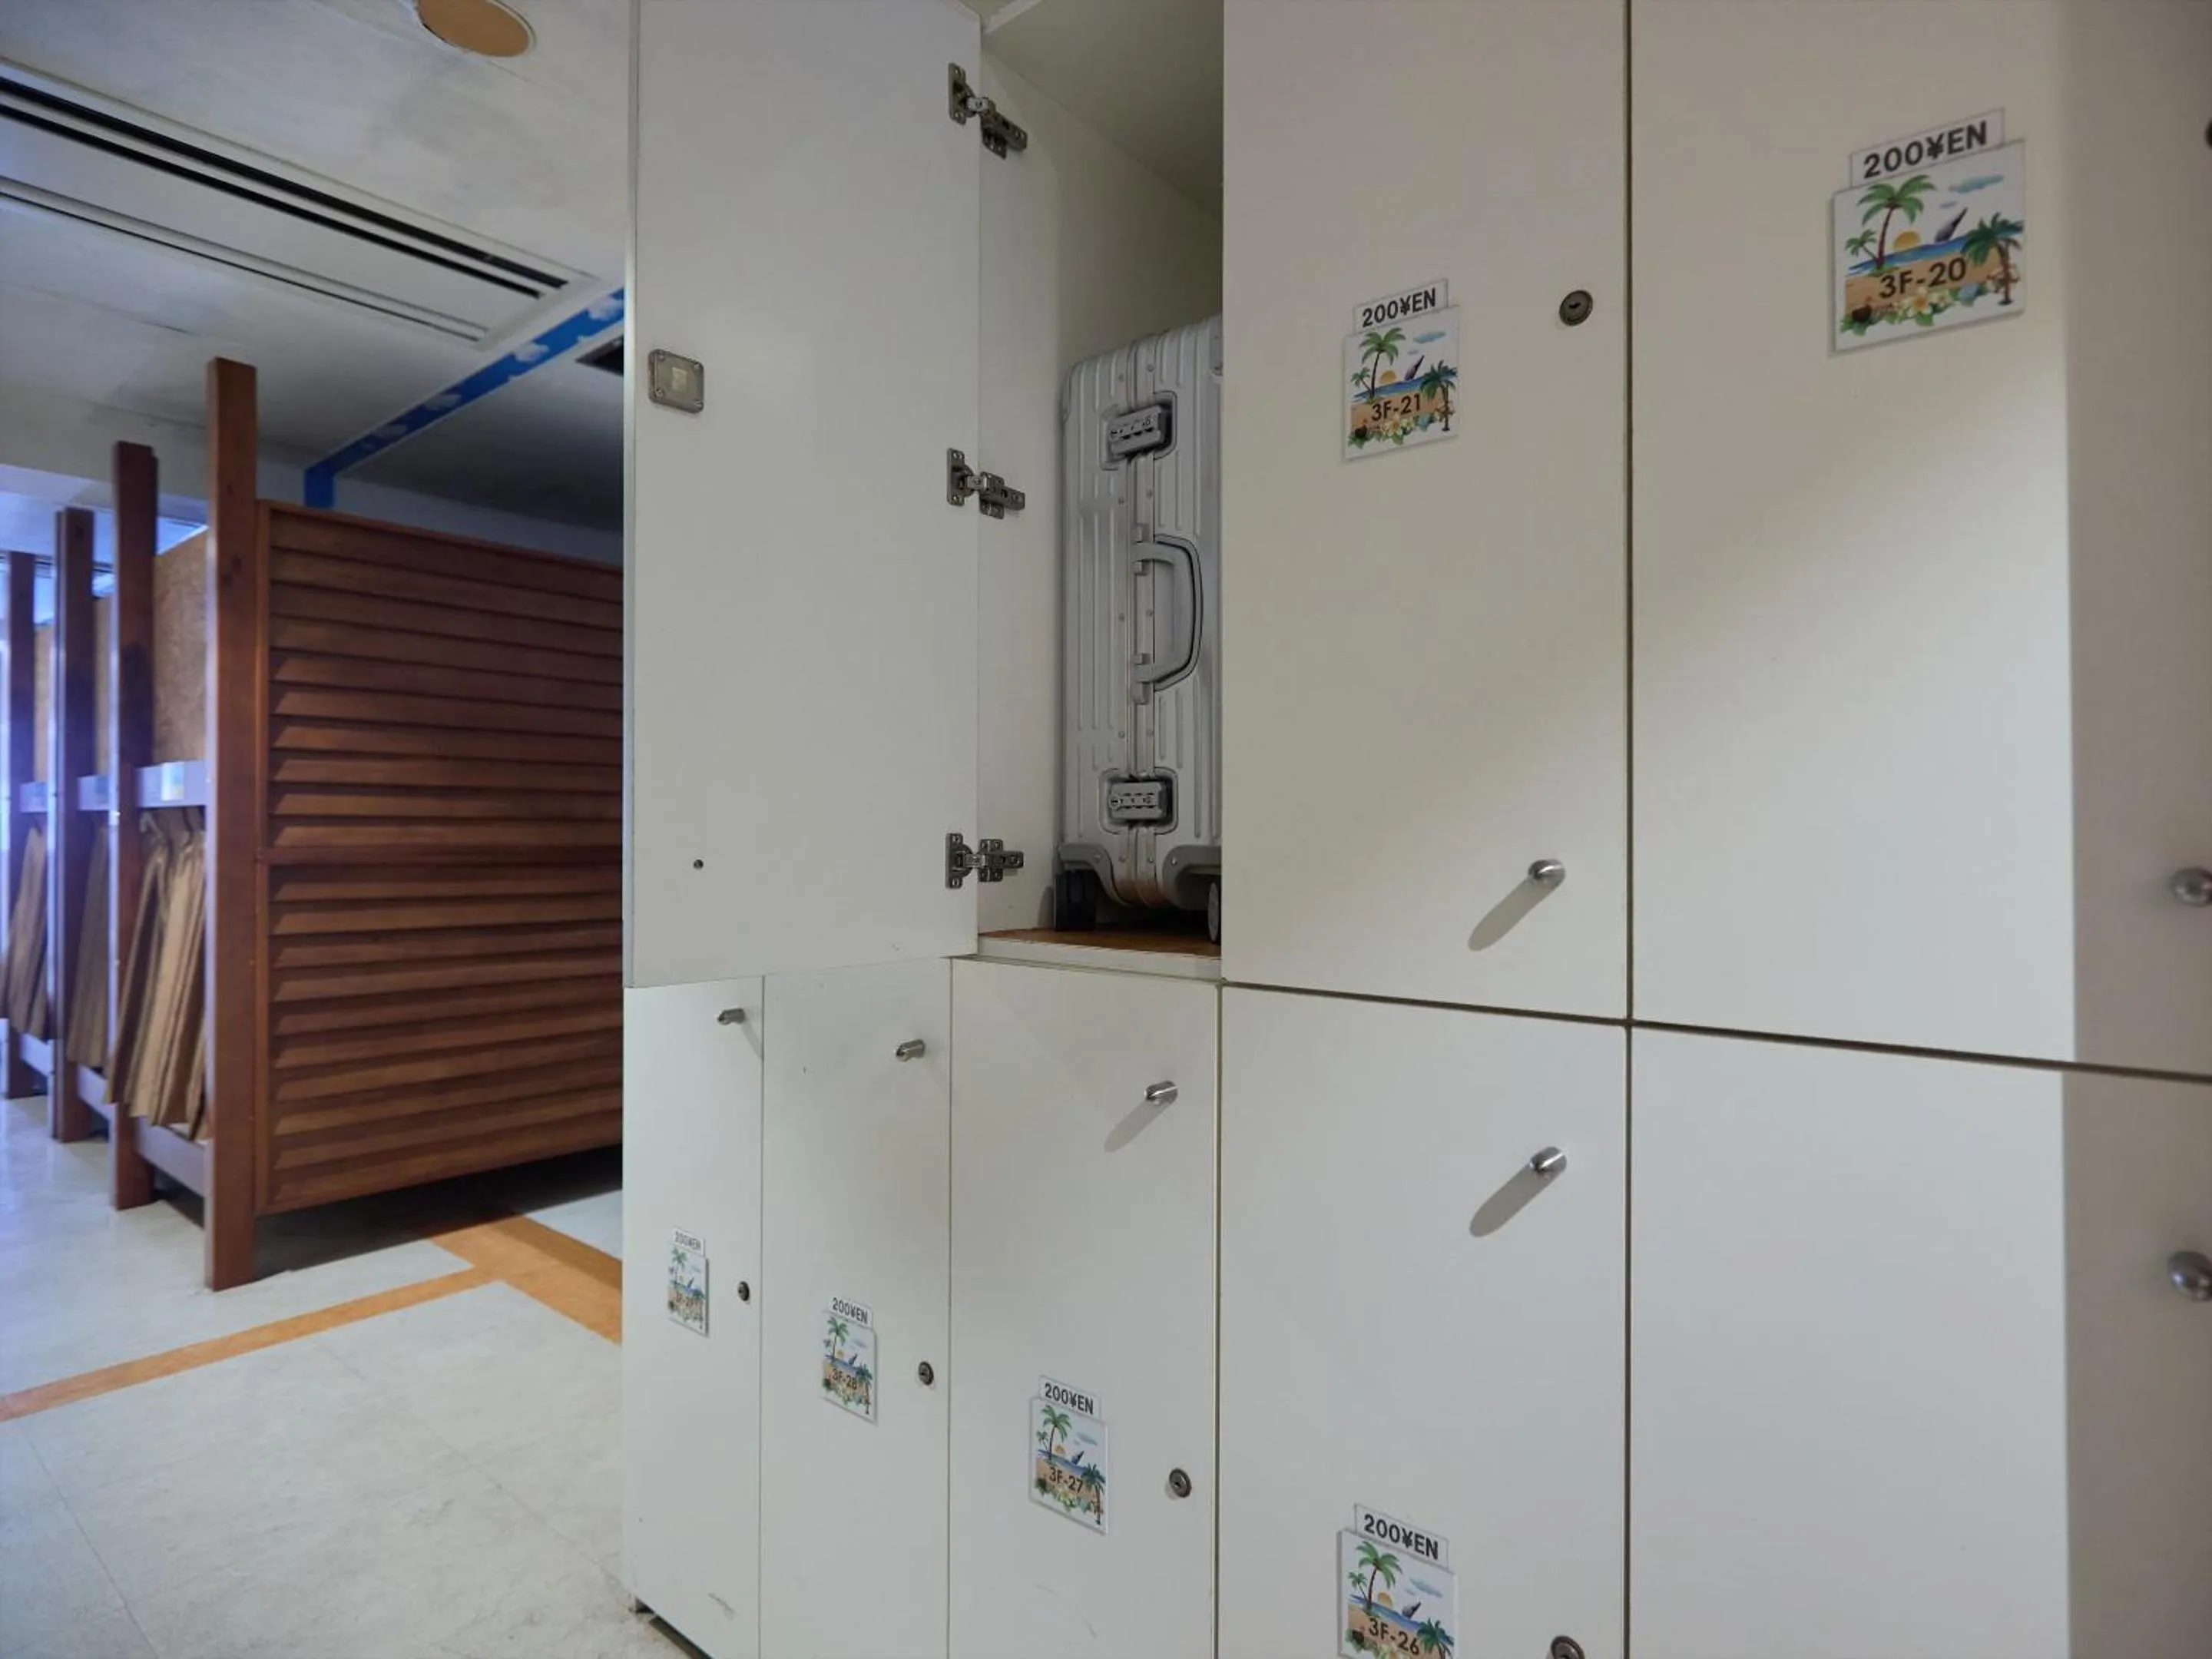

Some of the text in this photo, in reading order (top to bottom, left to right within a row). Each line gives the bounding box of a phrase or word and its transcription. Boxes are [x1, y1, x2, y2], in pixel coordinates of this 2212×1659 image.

[1863, 120, 1987, 179] 200¥EN
[1879, 257, 1966, 299] 3F-20
[1363, 287, 1436, 328] 200¥EN
[1372, 393, 1421, 422] 3F-21
[833, 1297, 868, 1325] 200¥EN
[1045, 1382, 1094, 1415] 200¥EN
[1049, 1466, 1082, 1493] 3F-27
[1364, 1513, 1439, 1560] 200¥EN
[1369, 1618, 1420, 1656] 3F-26
